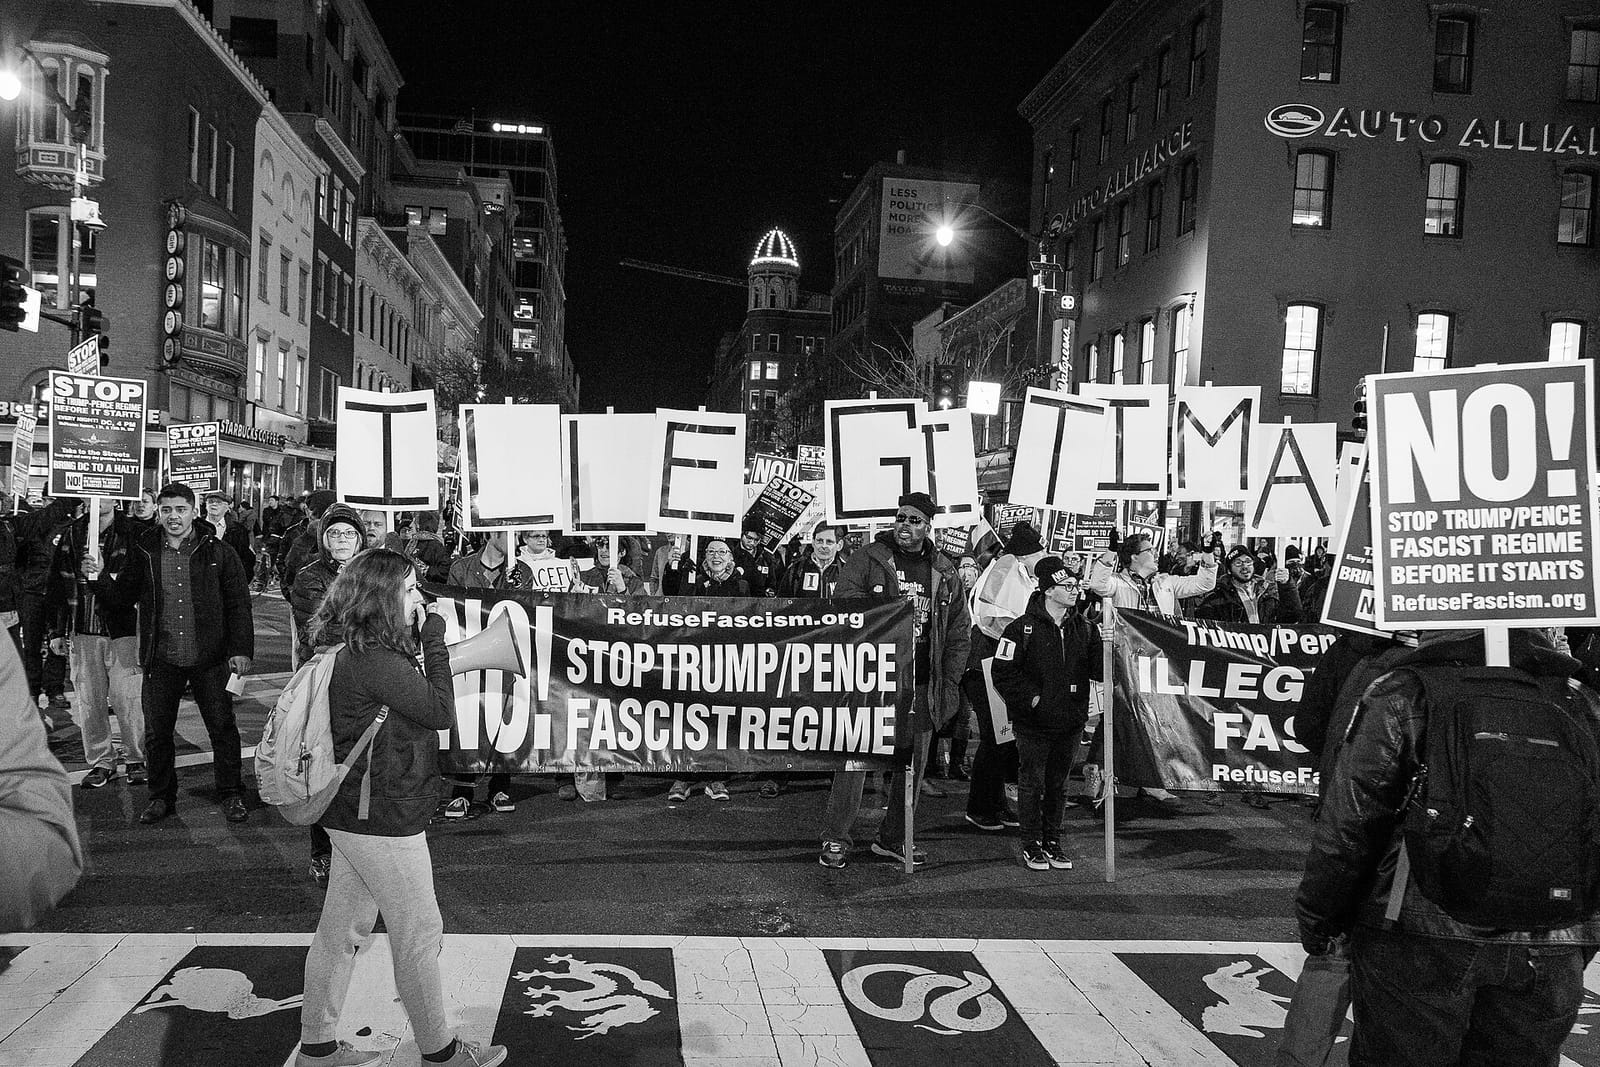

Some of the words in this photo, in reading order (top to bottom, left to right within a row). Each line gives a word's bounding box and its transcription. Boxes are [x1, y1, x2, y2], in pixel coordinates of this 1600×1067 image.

[1325, 107, 1448, 143] AUTO
[1458, 118, 1599, 156] ALLIA
[1104, 122, 1192, 204] ALLIANCE
[890, 188, 917, 198] LESS
[890, 201, 934, 211] POLITIC
[889, 213, 920, 223] MORE
[70, 340, 95, 368] STOP
[55, 376, 142, 402] STOP
[54, 404, 88, 414] BEFORE
[103, 409, 141, 418] STARTS
[17, 416, 34, 433] STOP
[169, 425, 216, 439] STOP
[220, 420, 258, 439] STARBUCKS
[258, 429, 280, 445] COFFEE
[800, 447, 825, 458] STO
[1383, 381, 1577, 504] NO!
[77, 461, 90, 472] DC
[91, 462, 103, 472] TO
[105, 463, 113, 472] A
[114, 464, 139, 474] HALT!
[67, 475, 81, 487] NO!
[770, 477, 812, 503] STOP
[1002, 508, 1033, 519] STOP
[1388, 510, 1438, 532] STOP
[1443, 504, 1582, 531] TRUMP/PENCE
[1390, 535, 1485, 558] FASCIST
[1492, 531, 1583, 555] REGIME
[1052, 570, 1069, 582] NO!
[1390, 563, 1474, 585] BEFORE
[1478, 562, 1498, 582] IT
[1502, 560, 1584, 582] STARTS
[1392, 592, 1586, 612] RefuseFascism.org
[607, 608, 865, 629] RefuseFascism.org
[1180, 619, 1337, 657] Trump/Pen
[1138, 656, 1305, 702] ILLEG
[567, 698, 736, 752] FASCIST
[740, 704, 896, 755] REGIME
[1213, 712, 1311, 753] FAS
[1212, 764, 1320, 786] RefuseFa
